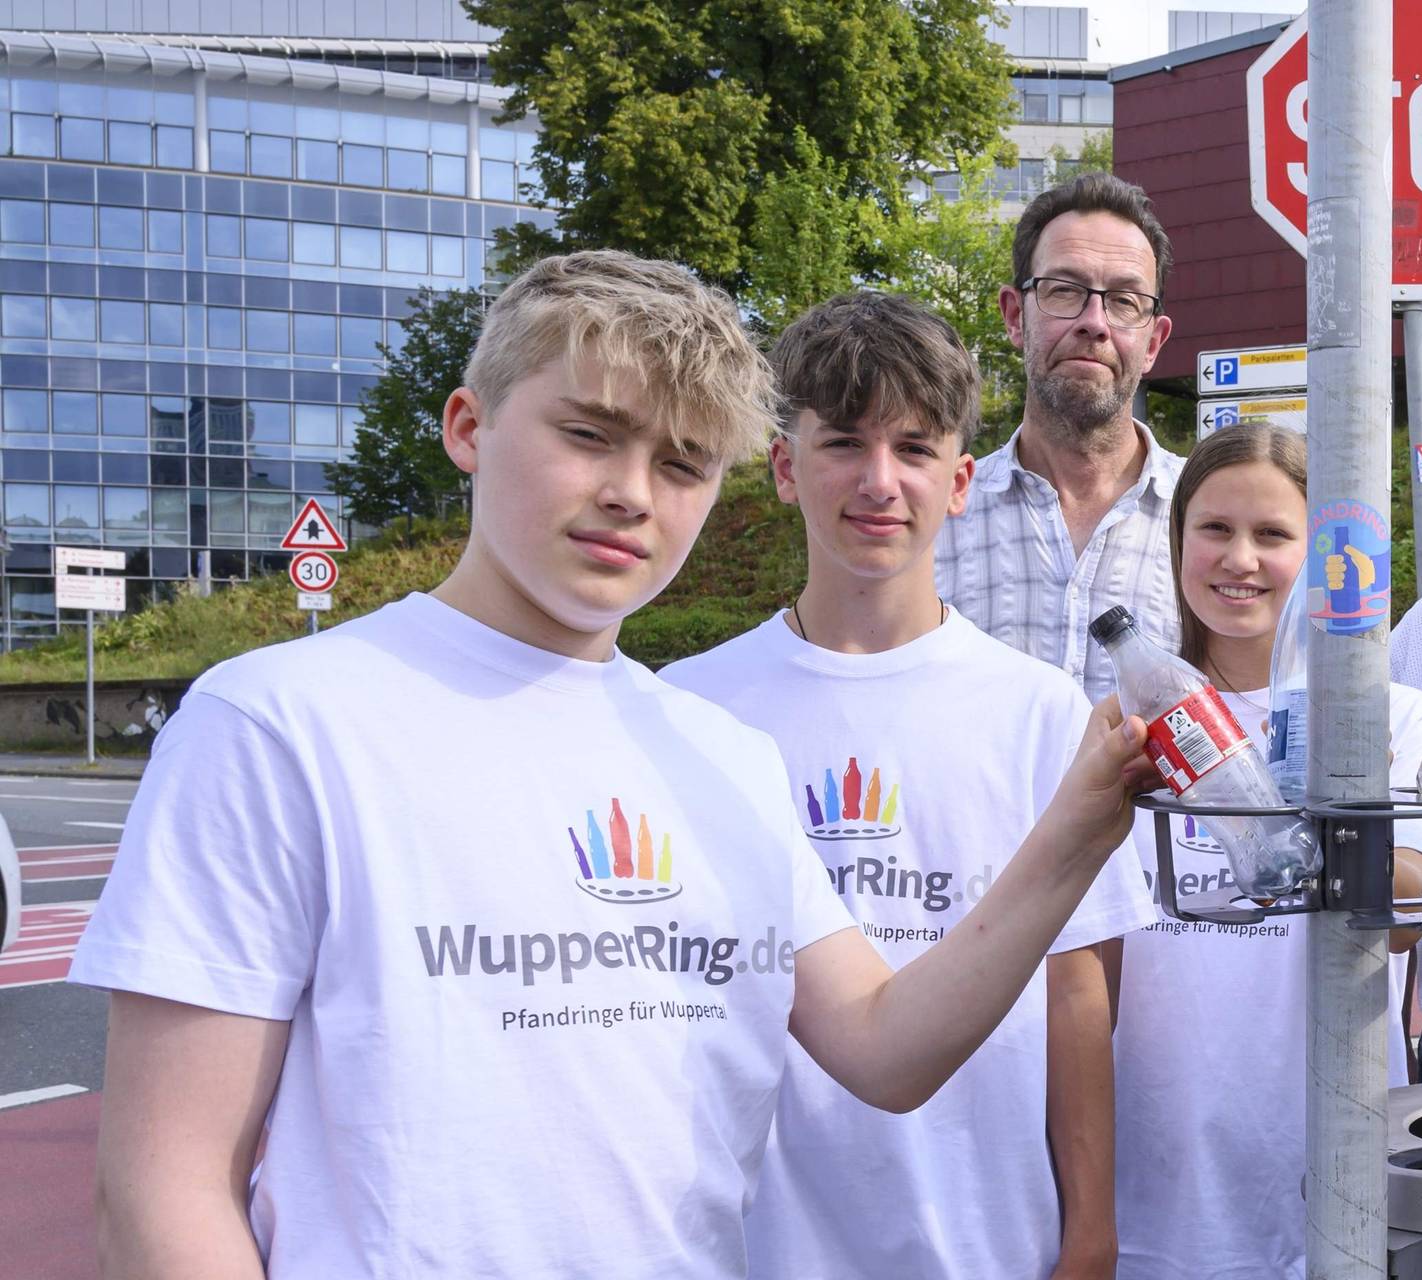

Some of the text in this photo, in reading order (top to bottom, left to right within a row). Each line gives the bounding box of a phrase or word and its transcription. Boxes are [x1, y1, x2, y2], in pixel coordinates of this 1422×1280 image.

[1220, 361, 1234, 383] P
[1309, 503, 1388, 541] ANDRING
[302, 562, 327, 581] 30
[863, 921, 944, 943] Wuppertal
[414, 920, 794, 986] WupperRing.de
[502, 999, 728, 1031] Pfandringe für Wuppertal
